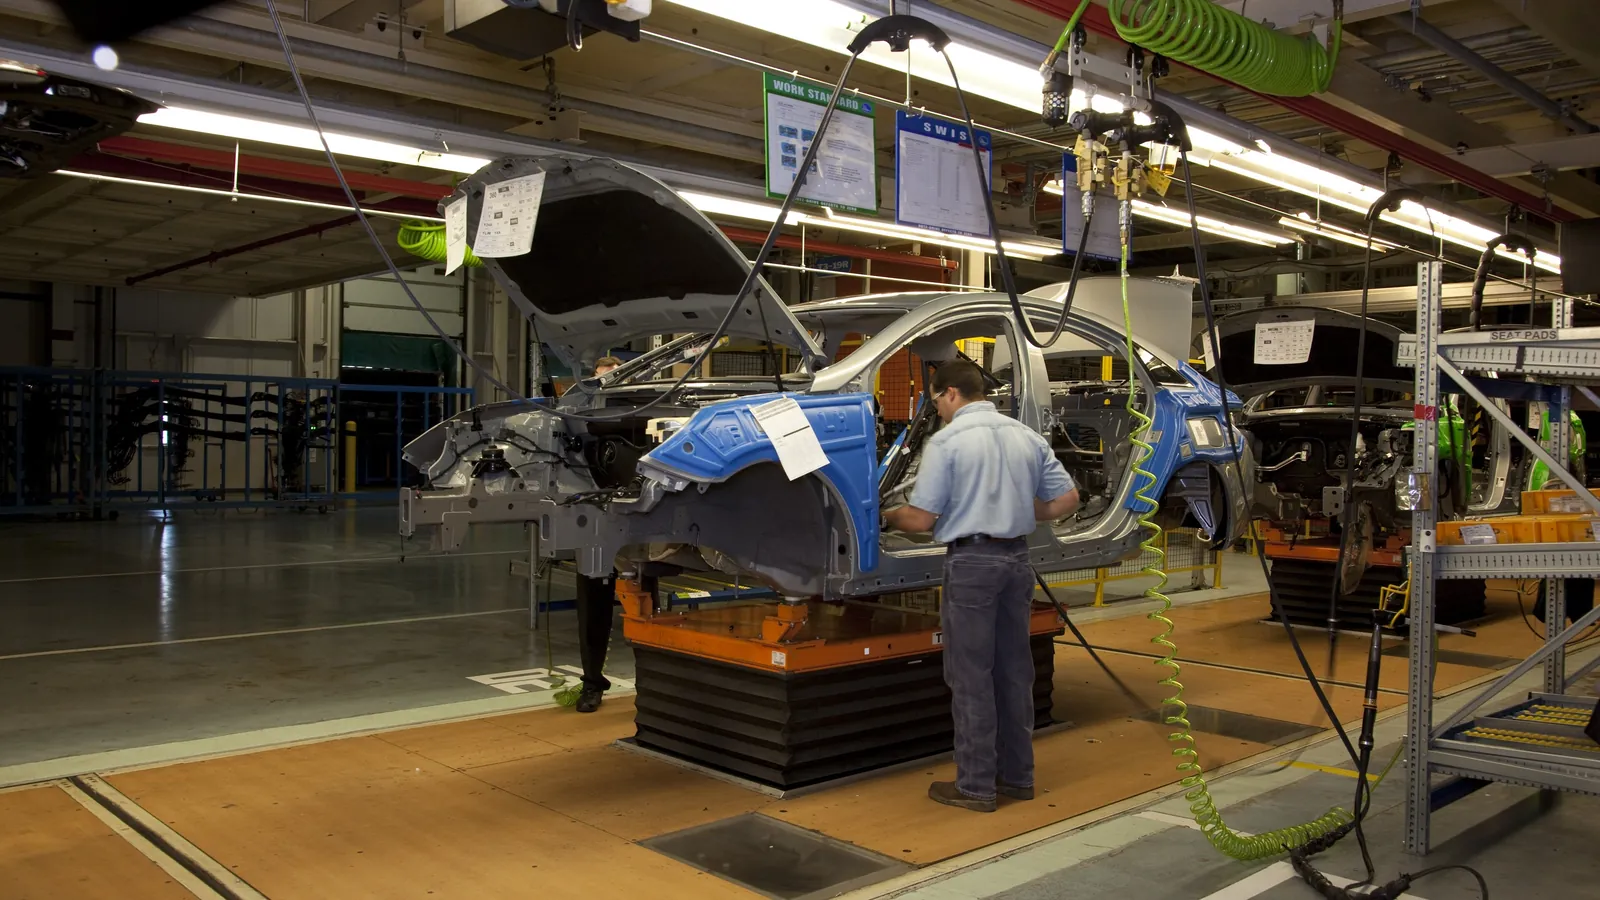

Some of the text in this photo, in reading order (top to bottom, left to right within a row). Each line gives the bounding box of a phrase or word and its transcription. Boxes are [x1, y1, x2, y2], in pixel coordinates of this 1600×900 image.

[773, 79, 859, 110] WORK STANARD
[1491, 330, 1557, 340] SEAT PADS
